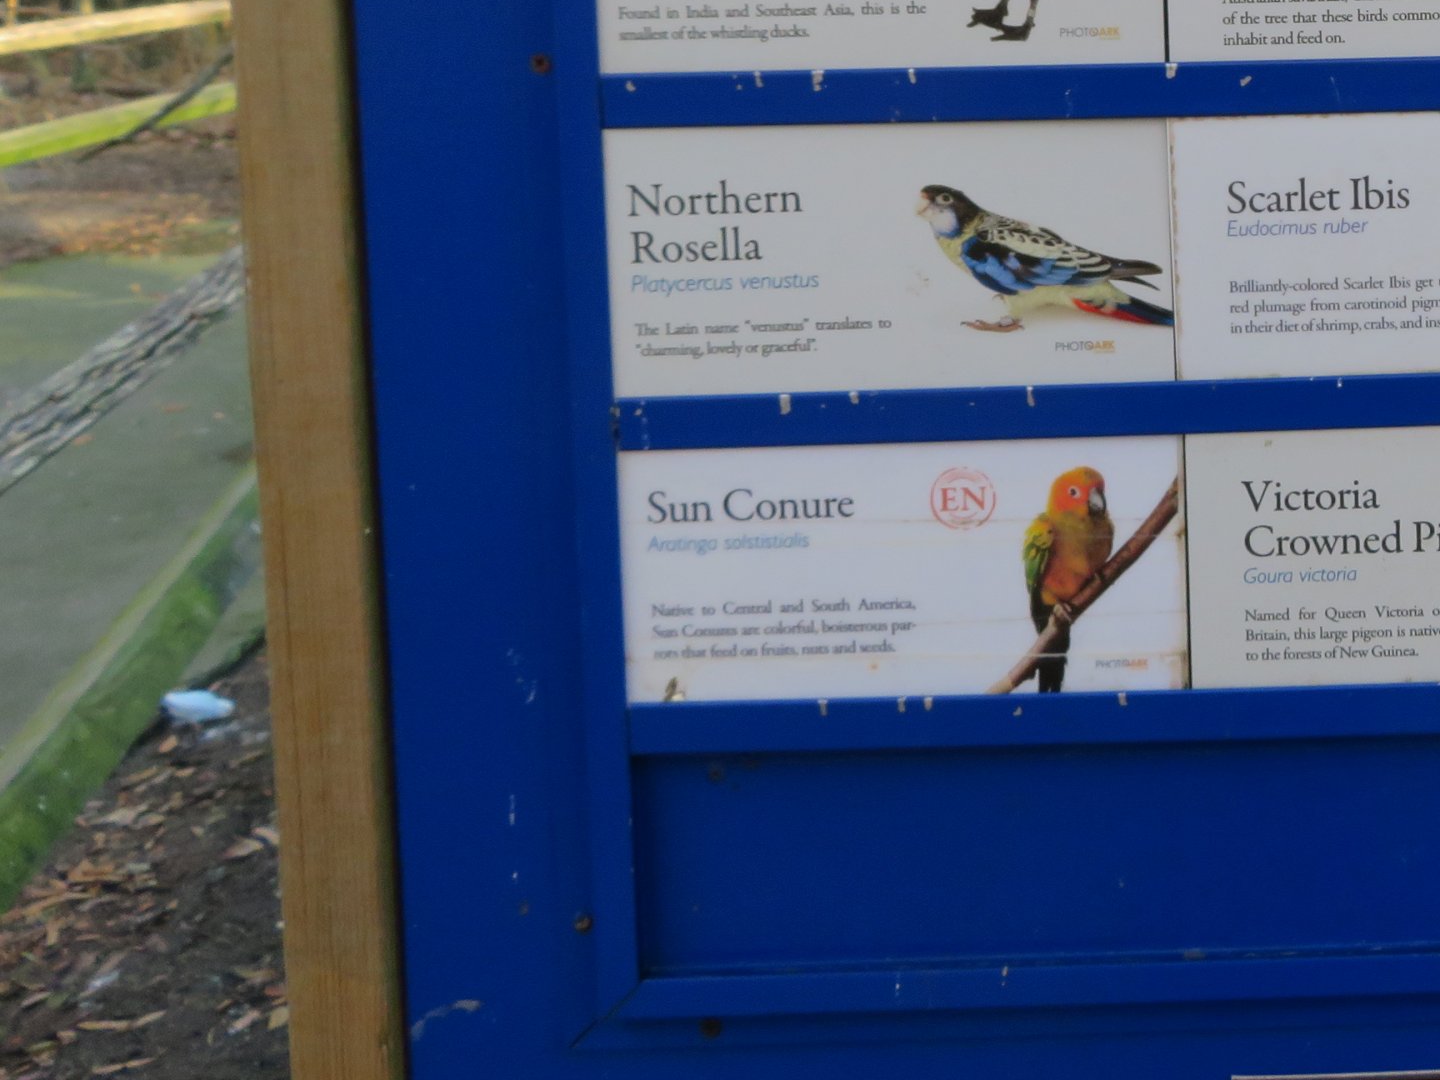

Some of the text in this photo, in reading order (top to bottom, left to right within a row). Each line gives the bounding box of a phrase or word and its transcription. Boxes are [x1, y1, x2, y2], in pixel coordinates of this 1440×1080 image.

[1222, 10, 1237, 24] of
[1240, 10, 1259, 24] the
[1264, 14, 1287, 23] tree
[1292, 11, 1317, 23] that
[1321, 8, 1352, 22] these
[1357, 7, 1388, 22] birds
[626, 178, 802, 216] Northern
[1227, 174, 1409, 213] Scarlet Ibis
[1226, 216, 1368, 237] Eudocimus ruber
[630, 226, 762, 263] Rosella
[1230, 299, 1249, 313] red
[1253, 298, 1306, 316] plumage
[1310, 296, 1340, 311] from
[647, 486, 853, 523] Sun Conure
[940, 487, 986, 512] EN
[1240, 478, 1380, 512] Victoria
[1244, 519, 1403, 557] Crowned
[1242, 566, 1357, 584] Goura victoria
[1244, 607, 1290, 621] Named
[1298, 605, 1316, 620] for
[1324, 605, 1366, 623] Queen
[1374, 604, 1424, 618] Victoria
